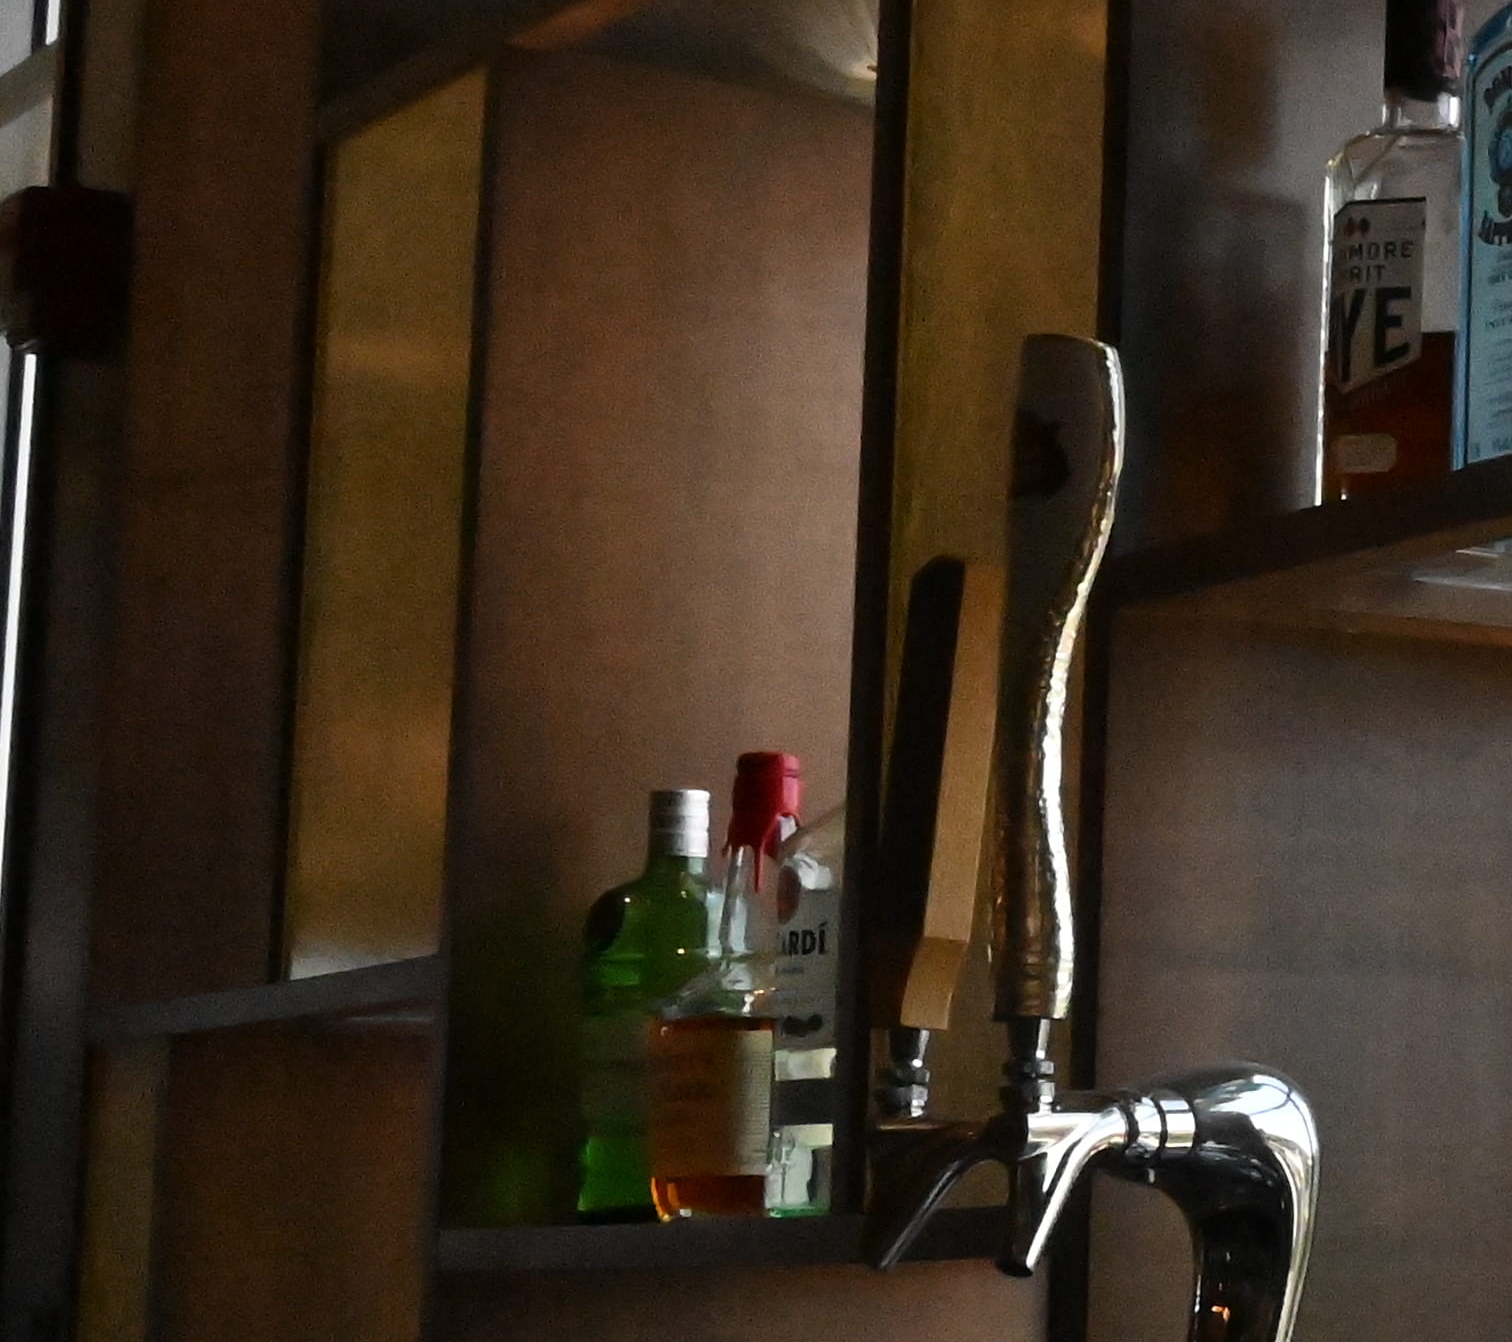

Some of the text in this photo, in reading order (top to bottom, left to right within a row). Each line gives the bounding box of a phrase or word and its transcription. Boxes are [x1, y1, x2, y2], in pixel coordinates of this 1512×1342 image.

[1344, 241, 1413, 261] MORE
[1346, 265, 1386, 283] RIT
[1331, 286, 1412, 381] YE
